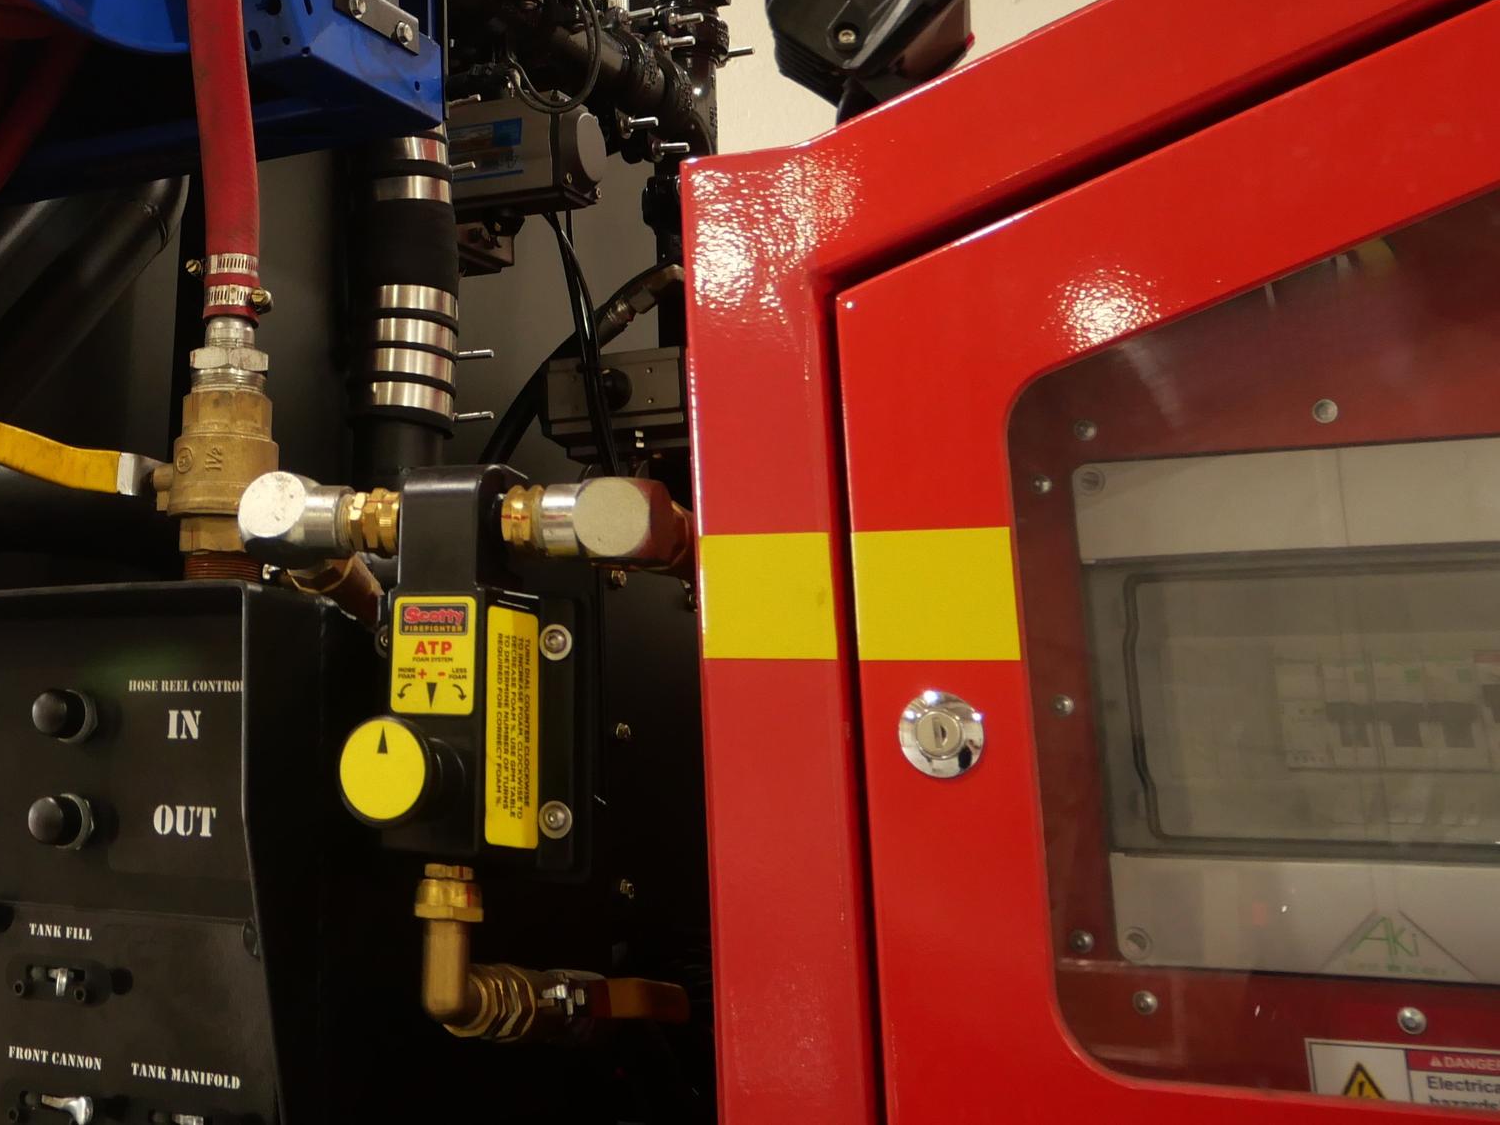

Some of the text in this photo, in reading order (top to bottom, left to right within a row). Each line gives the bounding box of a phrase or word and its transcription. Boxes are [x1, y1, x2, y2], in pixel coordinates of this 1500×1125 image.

[403, 606, 465, 626] Scotty
[414, 640, 453, 655] ATP
[128, 679, 244, 693] HOSE REEL CONTRO
[167, 709, 202, 740] IN
[153, 804, 218, 838] OUT
[29, 923, 93, 941] TANK FILL
[8, 1045, 102, 1071] FRONT CANNON
[1443, 1056, 1500, 1071] DANGE
[131, 1062, 241, 1090] TANK MANIFOLD
